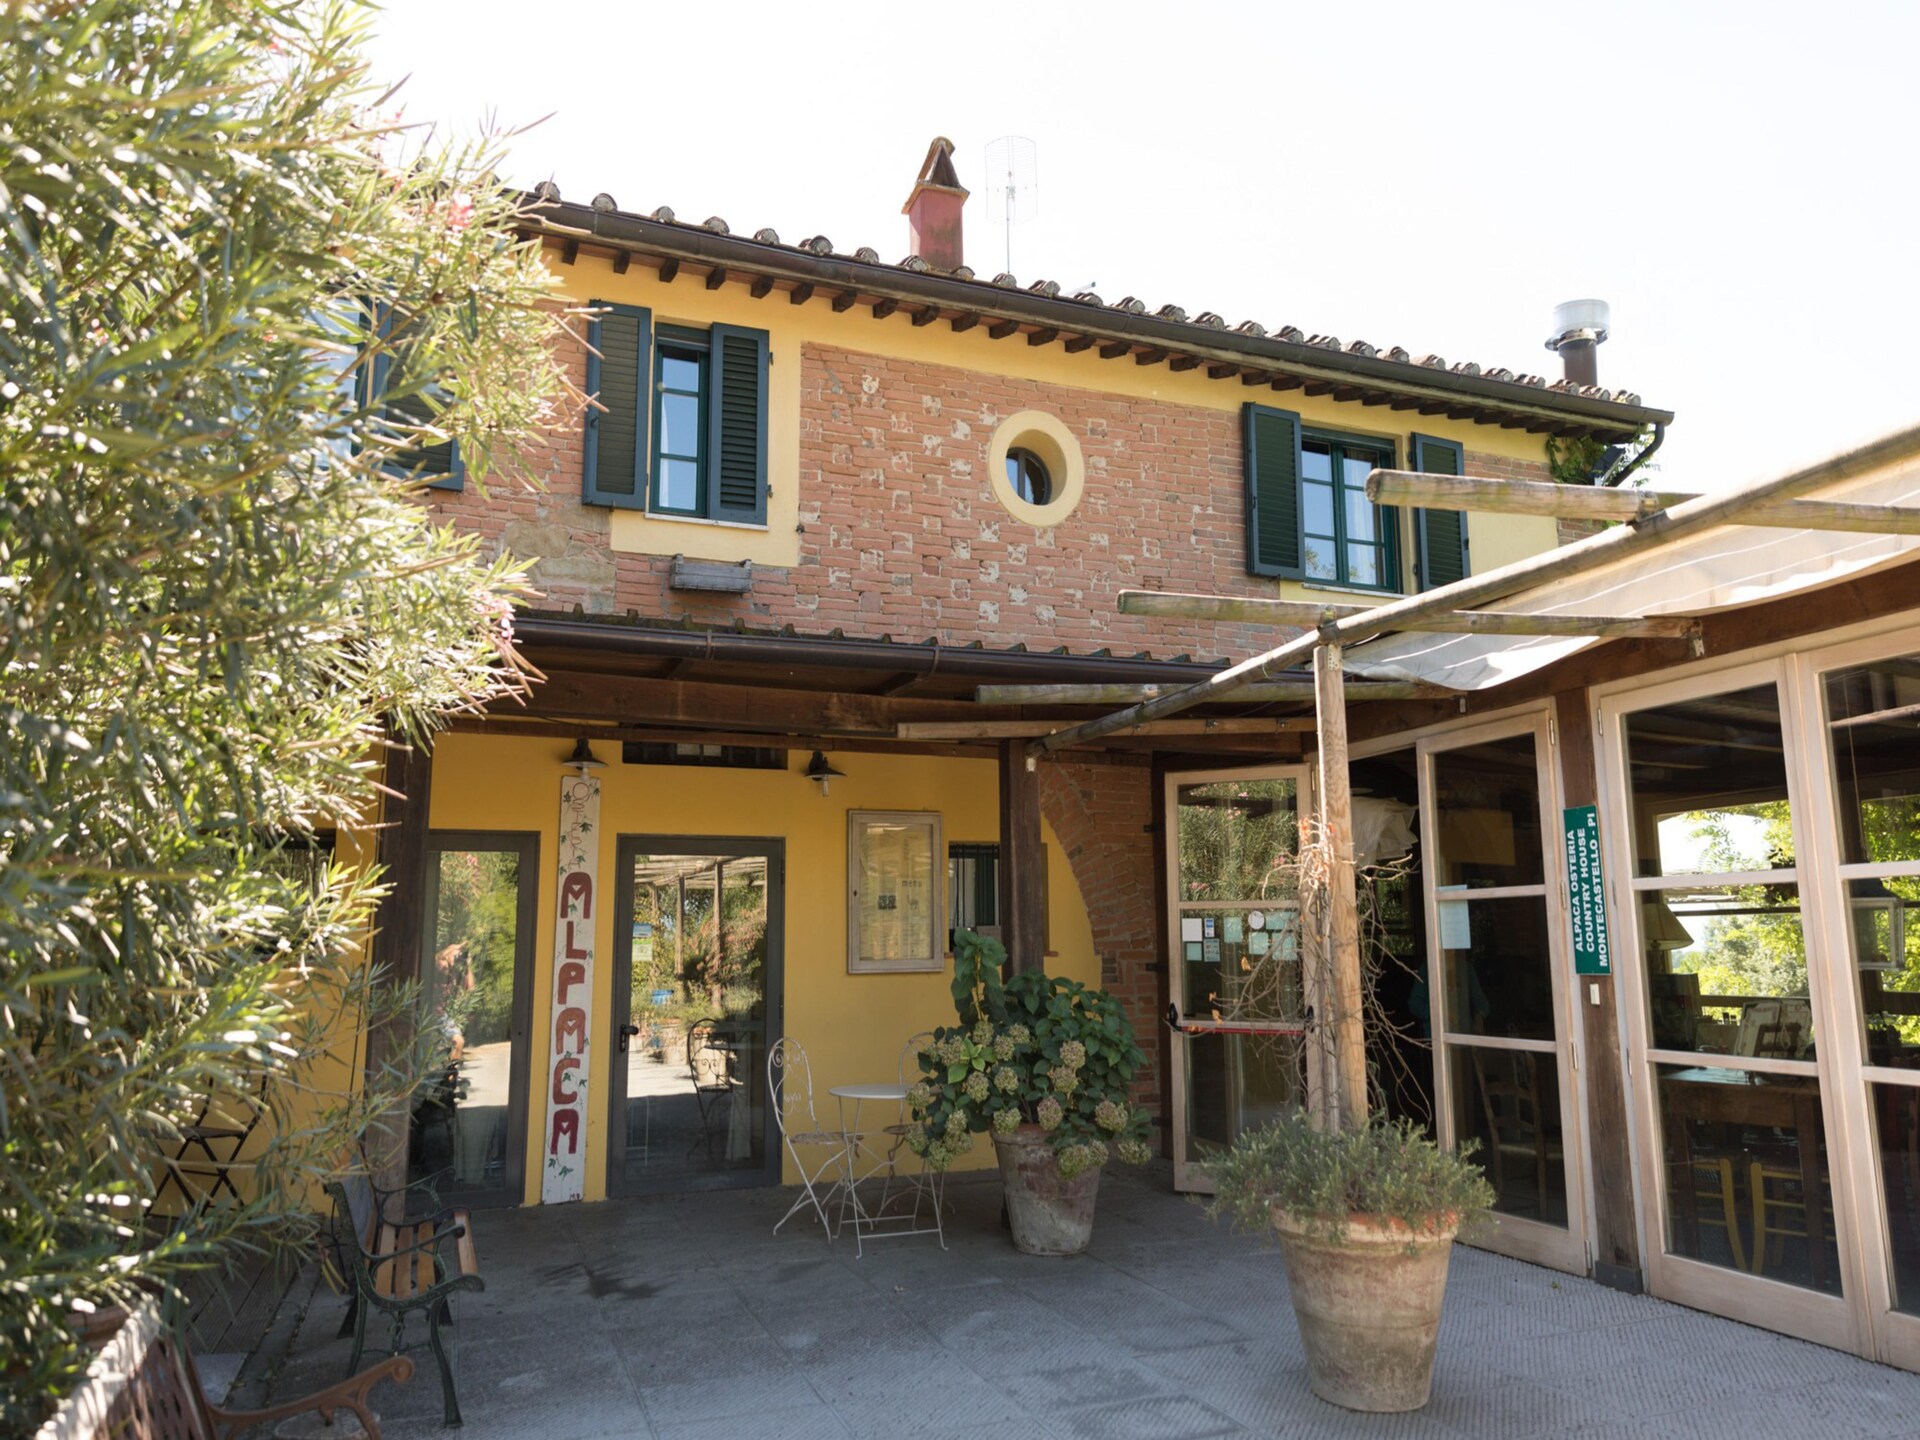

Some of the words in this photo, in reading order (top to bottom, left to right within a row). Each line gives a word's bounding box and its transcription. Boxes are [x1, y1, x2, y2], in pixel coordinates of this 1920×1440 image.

[1587, 812, 1596, 827] PI
[1567, 830, 1579, 892] OSTERIA
[1577, 828, 1589, 878] HOUSE
[1572, 896, 1584, 952] ALPACA
[1582, 883, 1595, 953] COUNTRY
[1589, 842, 1608, 967] MONTECASTELLO
[550, 871, 593, 1155] ALPACA
